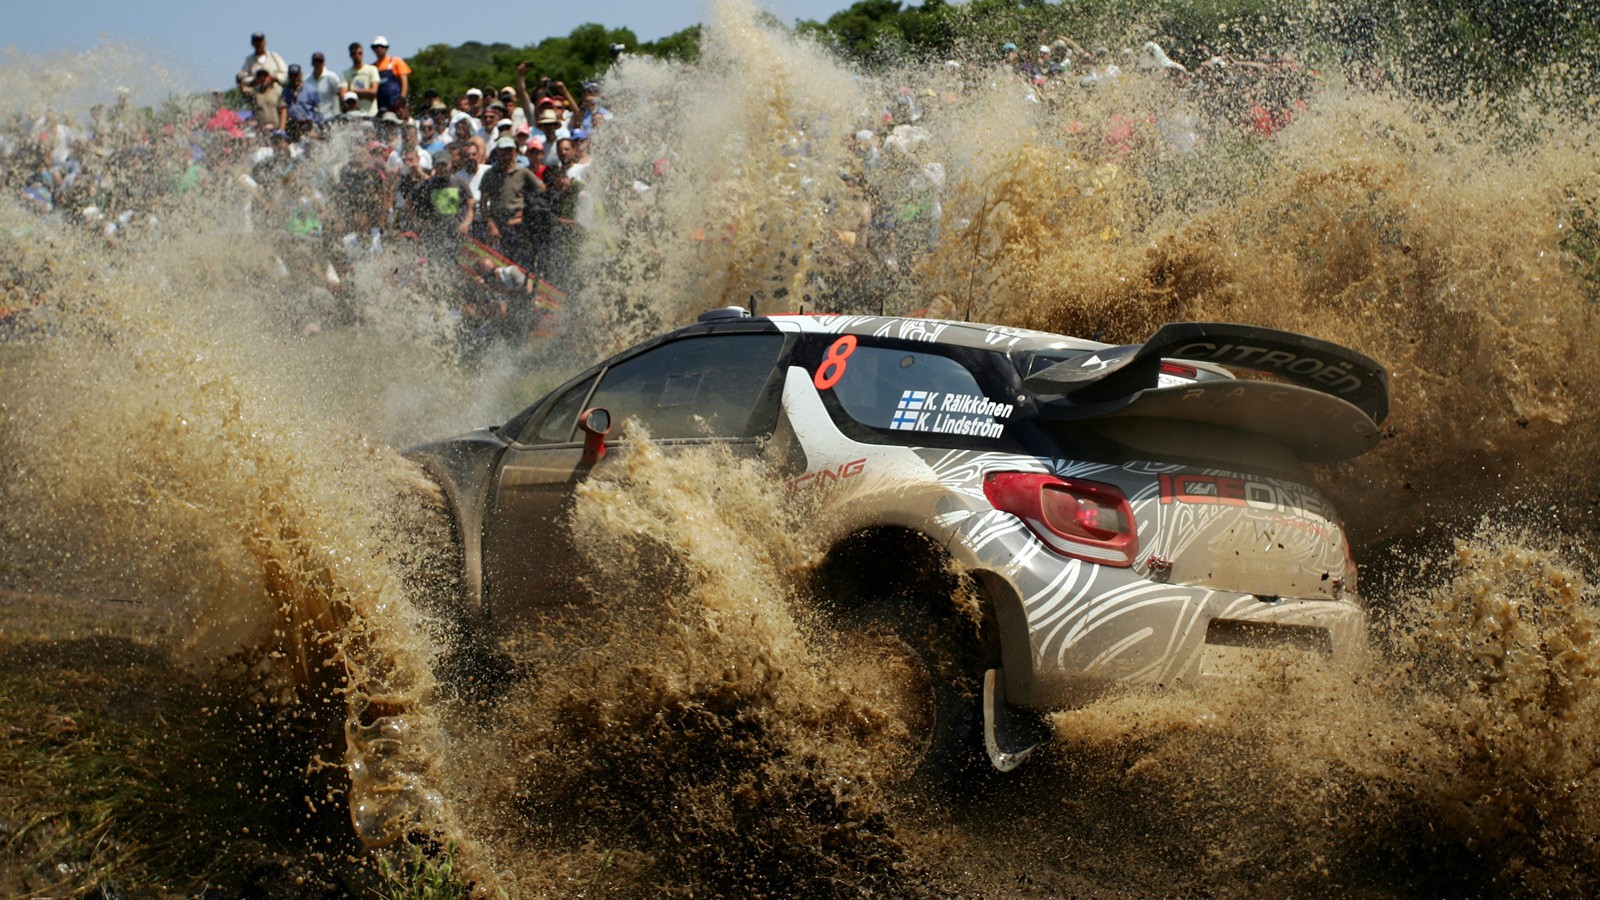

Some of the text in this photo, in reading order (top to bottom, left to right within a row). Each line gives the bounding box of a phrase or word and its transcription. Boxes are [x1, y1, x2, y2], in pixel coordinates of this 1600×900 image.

[814, 335, 857, 390] 8
[923, 391, 1014, 418] K. Räikkönen
[915, 412, 1005, 439] K. Lindström
[784, 458, 867, 494] CING
